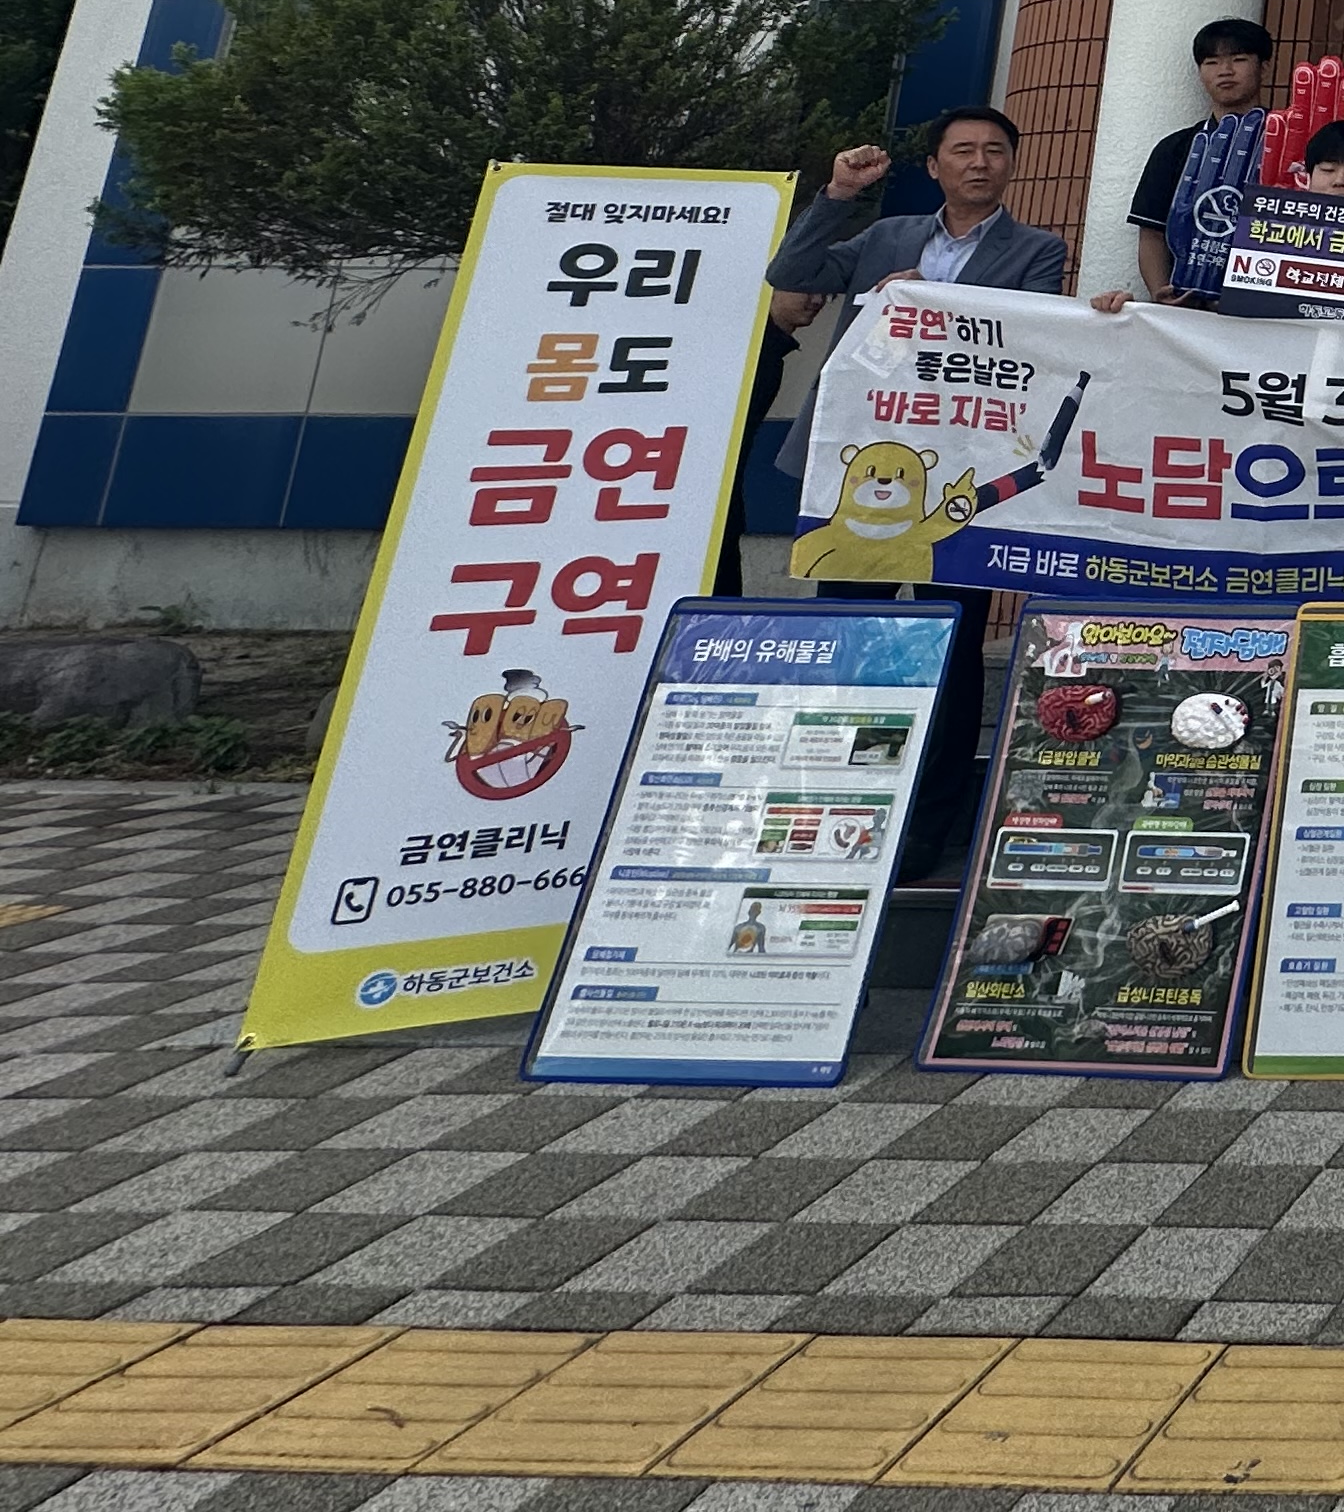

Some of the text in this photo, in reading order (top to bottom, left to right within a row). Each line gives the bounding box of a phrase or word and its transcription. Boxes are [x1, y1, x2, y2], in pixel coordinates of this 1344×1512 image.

[547, 200, 731, 226] 절대 잊지마세요!
[1254, 197, 1280, 215] 우리
[1282, 200, 1321, 220] 모두의
[1249, 219, 1324, 251] 학교에서
[547, 243, 701, 307] 우리
[1231, 274, 1272, 287] SMOKING
[526, 333, 672, 402] 몸도
[914, 349, 1036, 392] 좋은날은?
[1220, 370, 1308, 422] 5월
[469, 426, 688, 527] 금연
[987, 543, 1031, 575] 지금
[1036, 550, 1080, 579] 바로
[1085, 553, 1219, 593] 하동군보건소
[429, 552, 659, 656] 구역
[692, 638, 837, 664] 담배의 유해물질
[400, 821, 570, 865] 금연클리닉
[386, 863, 587, 909] 055-880-666
[401, 959, 536, 995] 하동군보건소
